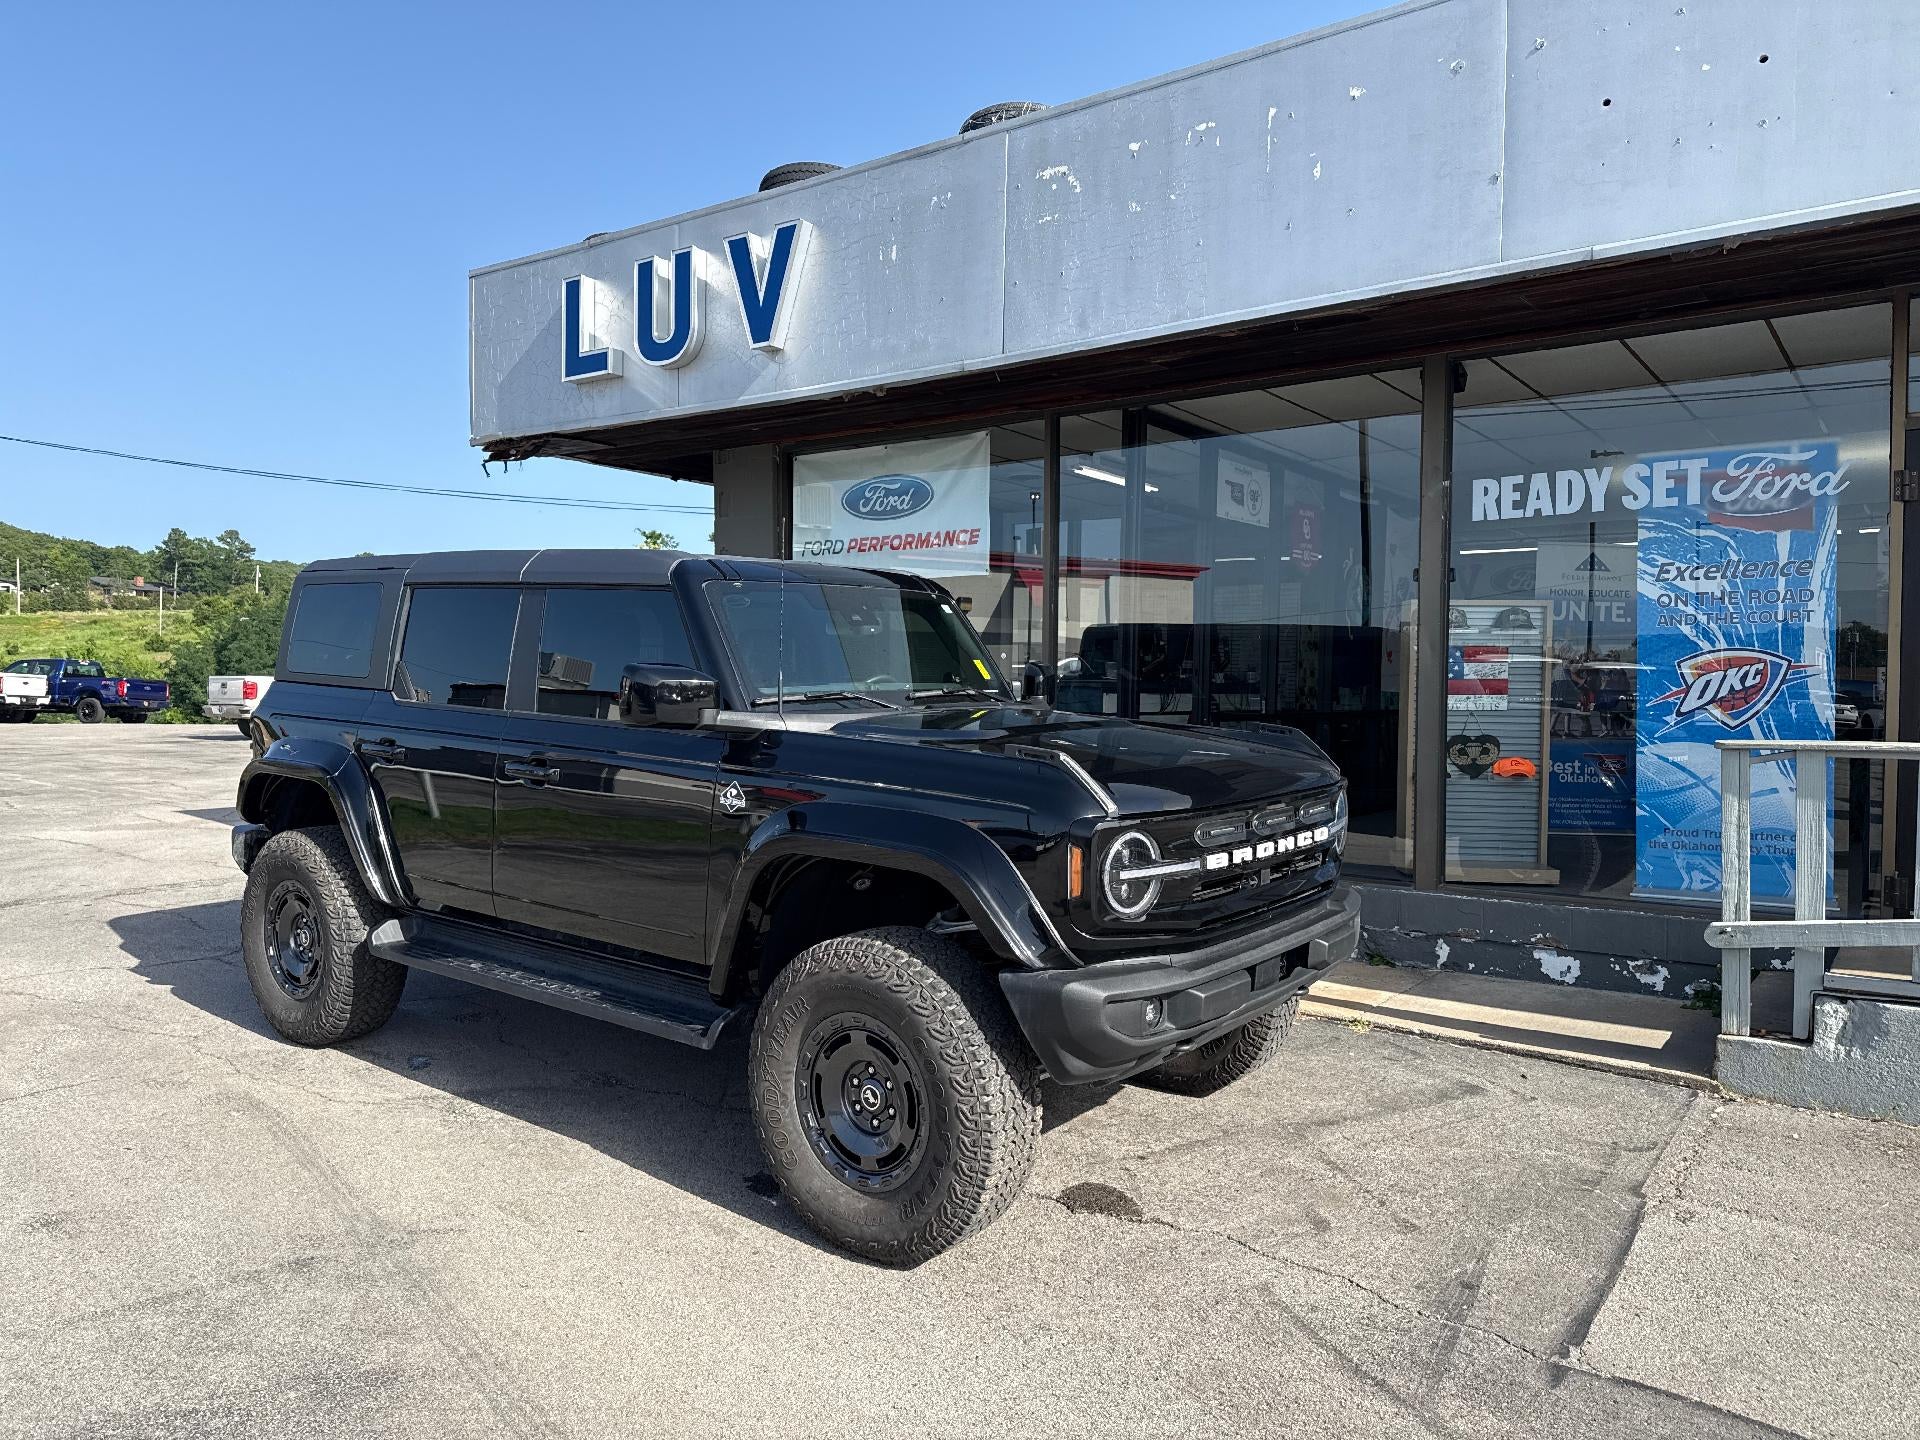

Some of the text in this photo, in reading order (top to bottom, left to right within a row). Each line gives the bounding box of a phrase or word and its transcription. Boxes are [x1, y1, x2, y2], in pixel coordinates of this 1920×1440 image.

[562, 218, 808, 384] LUV
[859, 483, 915, 513] Ford
[1471, 450, 1851, 522] READY SET Ford
[802, 528, 981, 557] FORD PERFORMANCE
[1655, 558, 1814, 582] Excellence
[1656, 588, 1815, 608] ON THE ROAD
[1656, 609, 1815, 627] AND THE COURT
[1680, 662, 1766, 713] OKC
[1584, 764, 1595, 774] in
[1206, 827, 1329, 870] BRONCO
[1648, 840, 1669, 849] the
[1664, 827, 1699, 838] Proud
[1750, 832, 1785, 842] artner
[761, 996, 811, 1170] GOODYEAR
